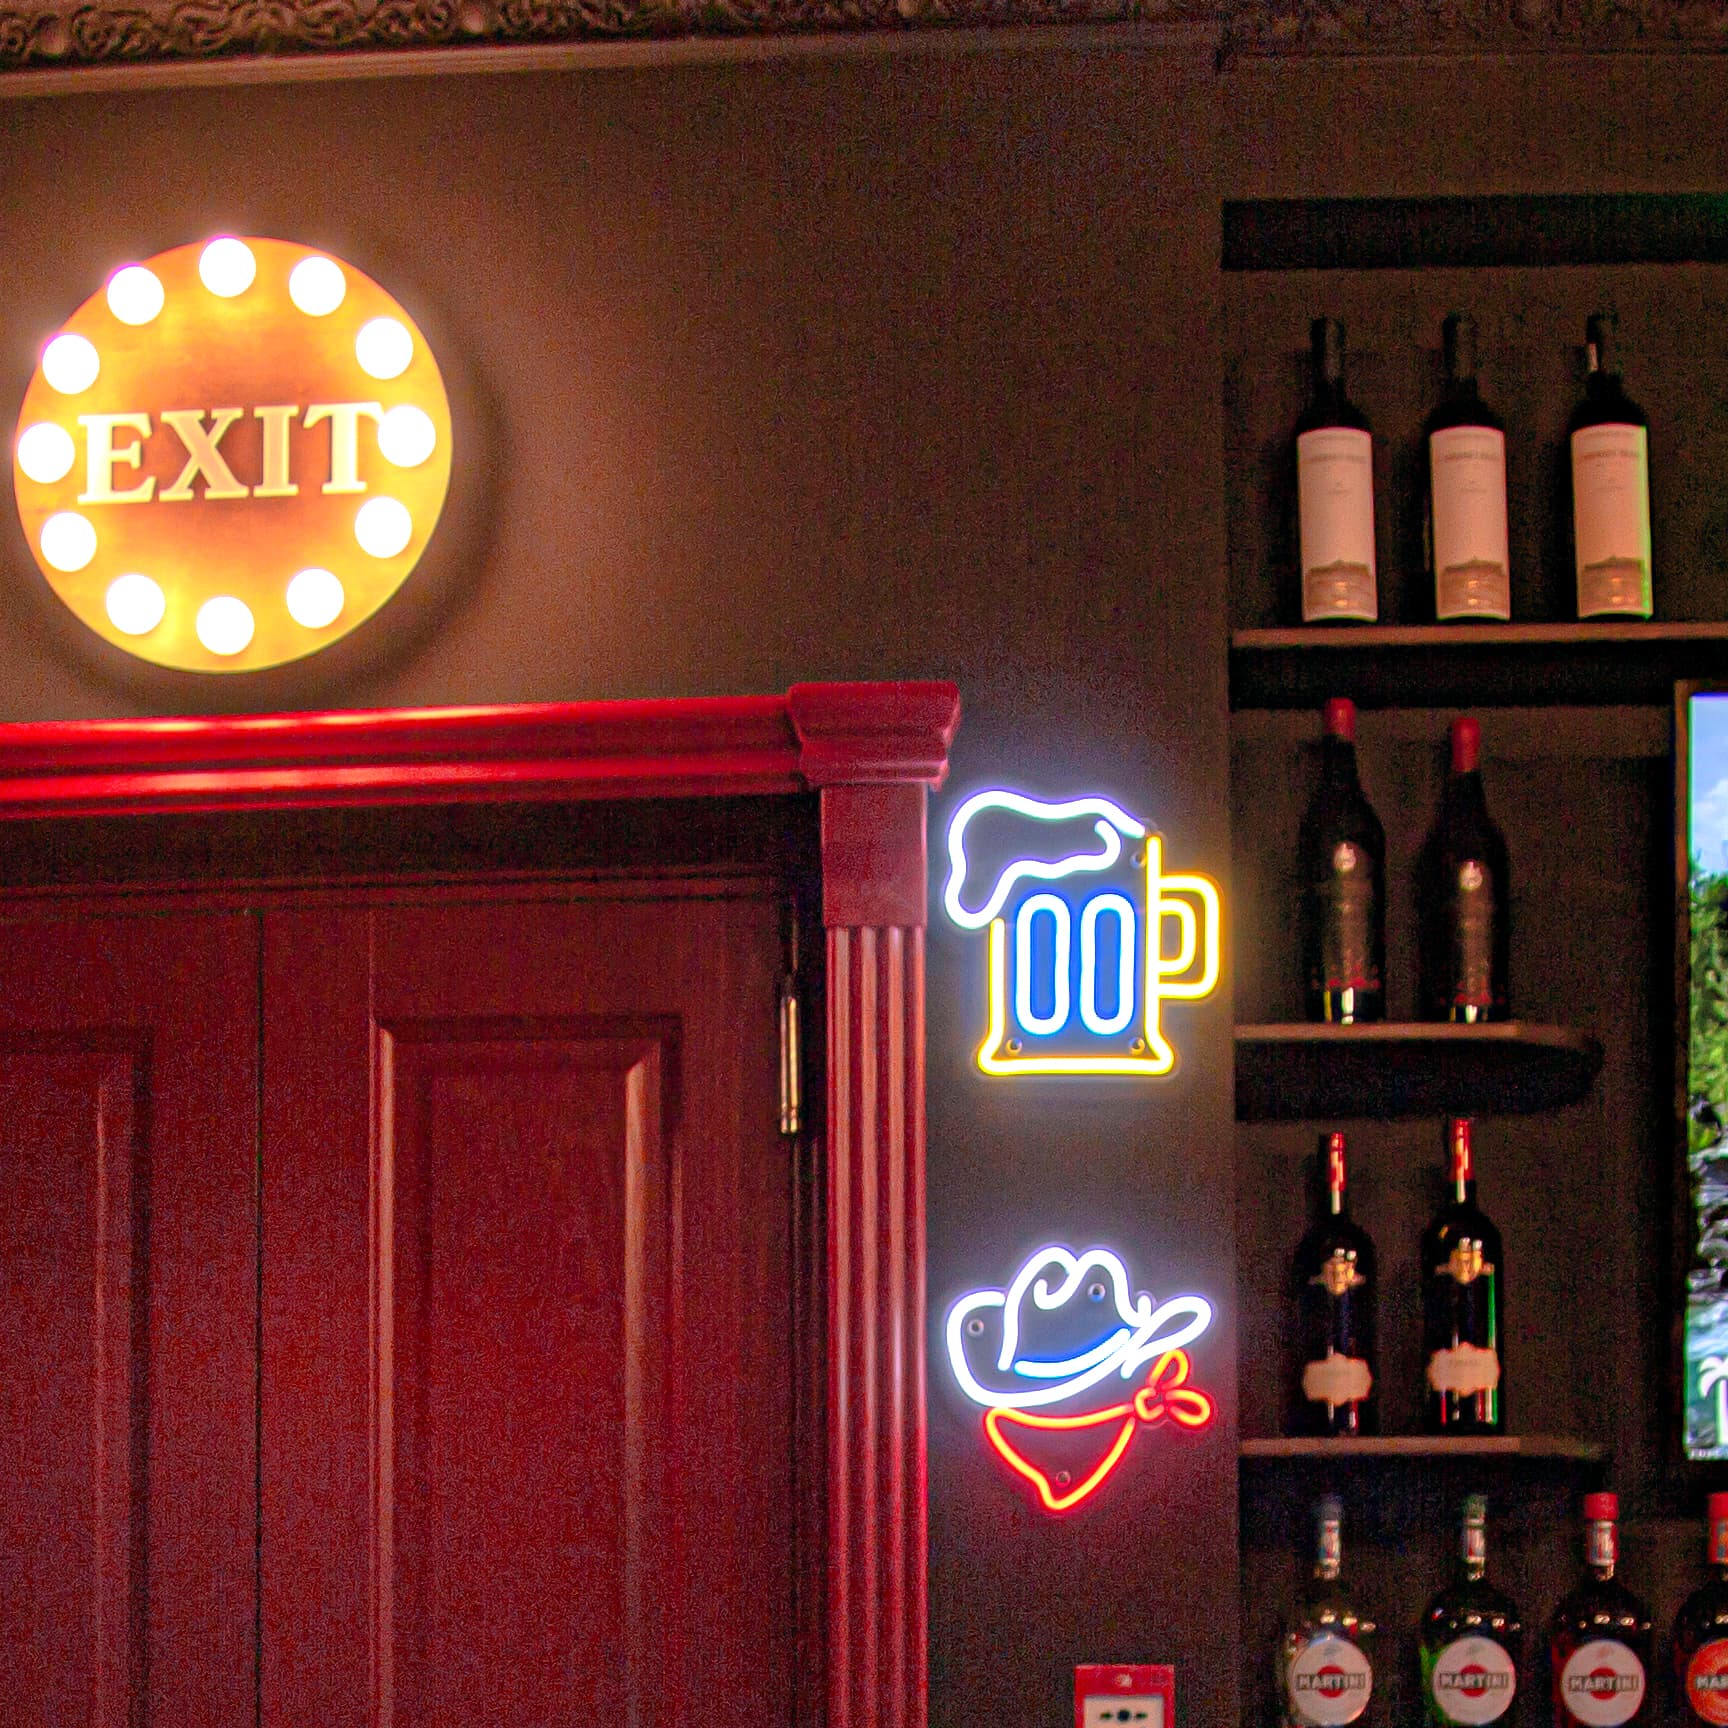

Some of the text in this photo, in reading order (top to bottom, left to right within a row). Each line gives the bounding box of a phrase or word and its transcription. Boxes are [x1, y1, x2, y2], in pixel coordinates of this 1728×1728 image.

[77, 401, 385, 505] EXIT
[1296, 1672, 1365, 1692] MARTINI
[1438, 1671, 1508, 1690] MARTINI
[1568, 1673, 1639, 1693] MARTINI
